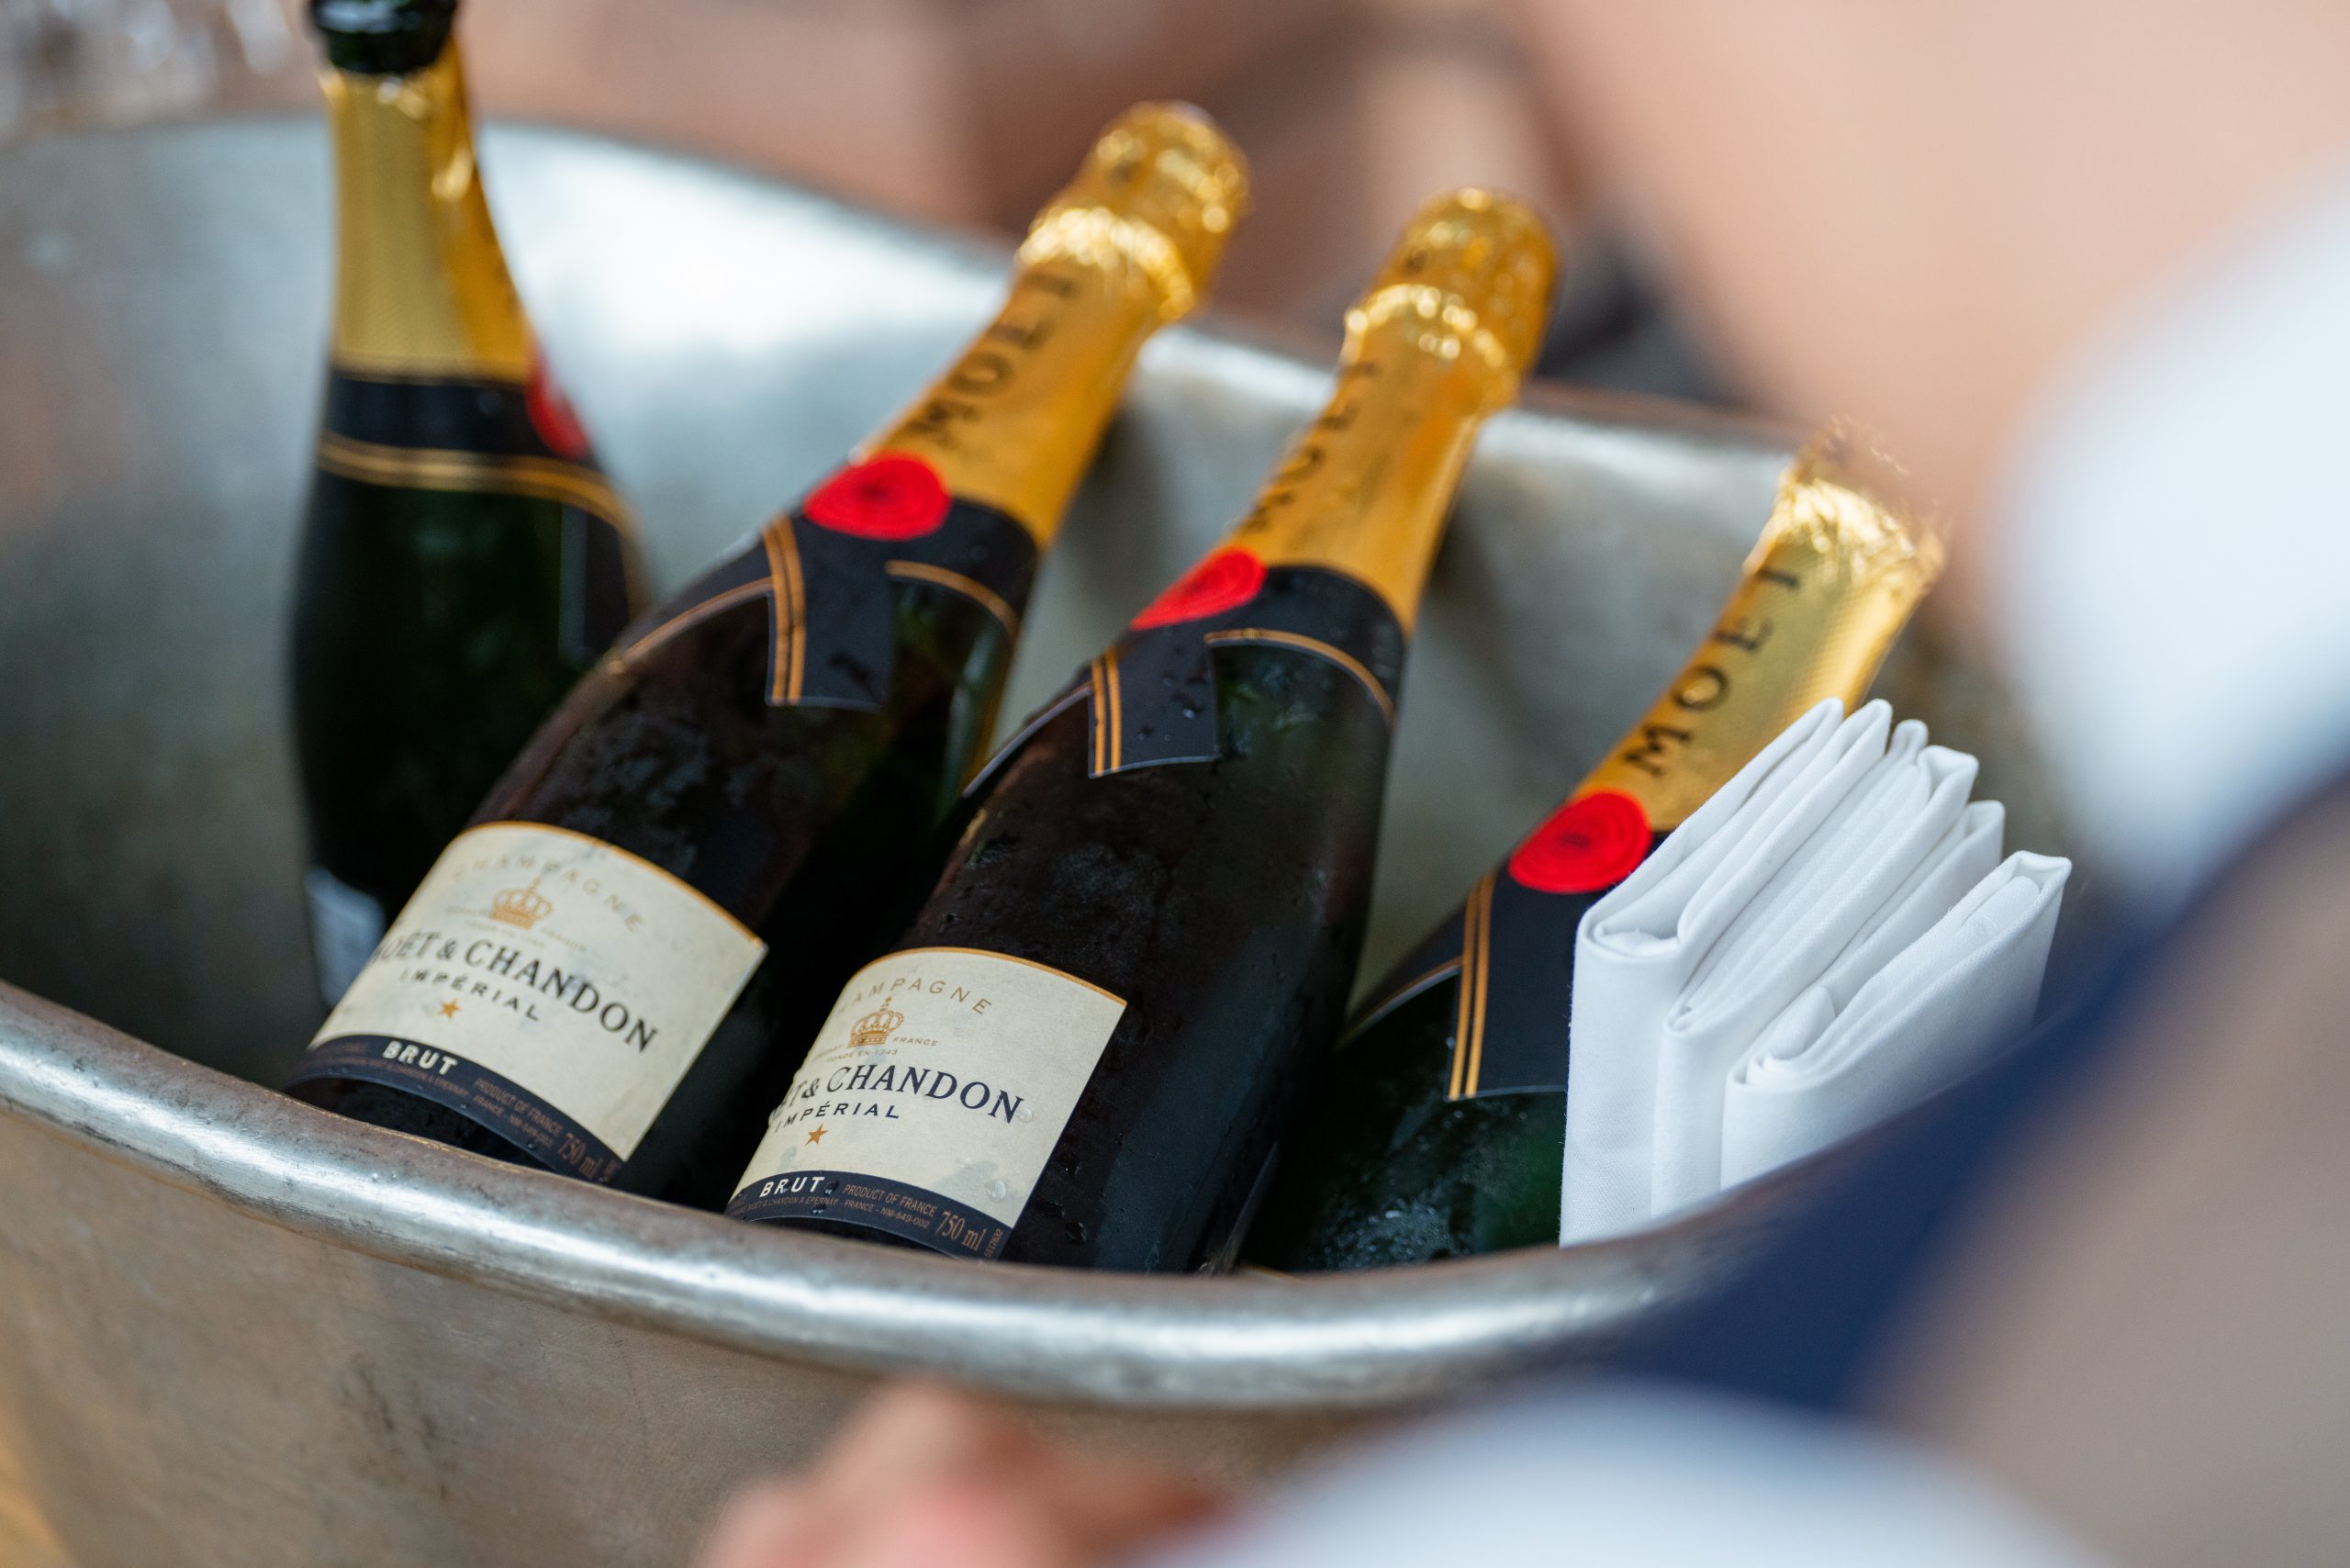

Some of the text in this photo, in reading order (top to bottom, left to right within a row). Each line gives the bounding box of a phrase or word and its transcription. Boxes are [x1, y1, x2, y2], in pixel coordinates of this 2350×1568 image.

[398, 968, 540, 1022] IMPÉRIAL
[436, 938, 457, 962] &
[464, 938, 658, 1053] CHANDON
[382, 1040, 458, 1076] BRUT
[893, 1036, 939, 1047] FRANCE
[800, 1078, 820, 1099] &
[827, 1064, 1024, 1124] CHANDON
[775, 1101, 900, 1133] IMPÉRIAL
[558, 1132, 588, 1166] 750
[759, 1176, 825, 1198] BRUT
[844, 1184, 937, 1218] PRODUCT OF FRANCE
[844, 1199, 875, 1213] FRANCE
[935, 1211, 987, 1252] 750 ml
